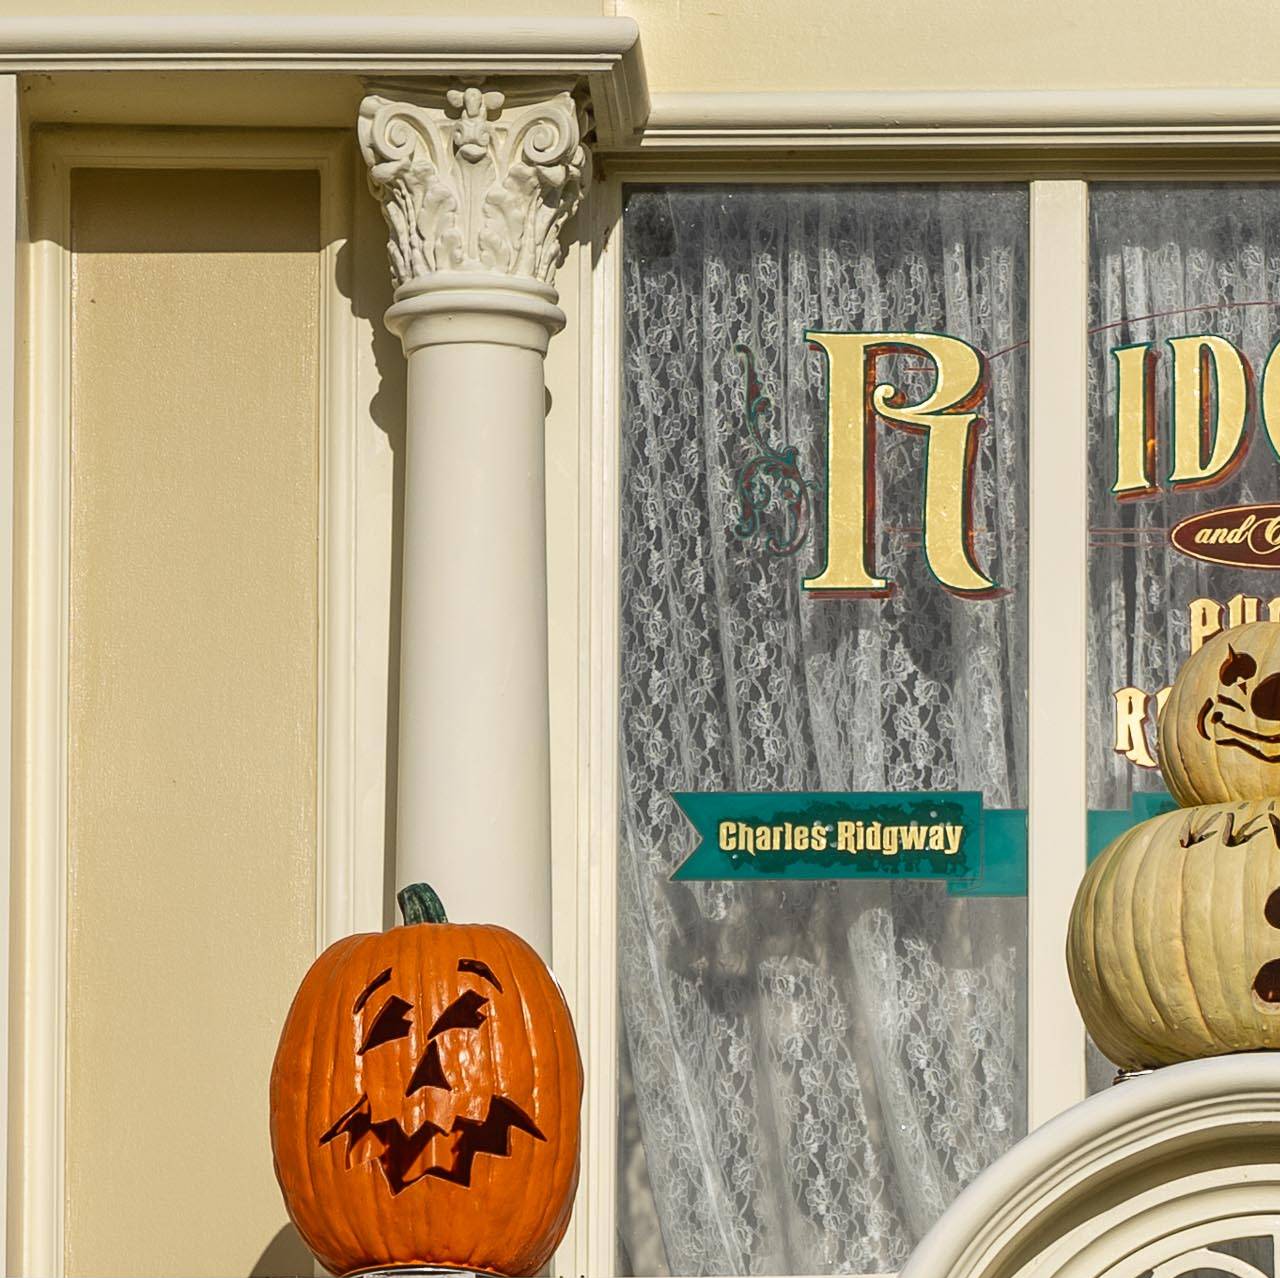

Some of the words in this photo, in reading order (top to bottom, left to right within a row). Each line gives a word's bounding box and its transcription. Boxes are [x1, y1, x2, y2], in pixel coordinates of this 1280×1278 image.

[1195, 514, 1256, 544] and
[718, 820, 827, 856] Charles
[837, 820, 963, 855] Ridgway
